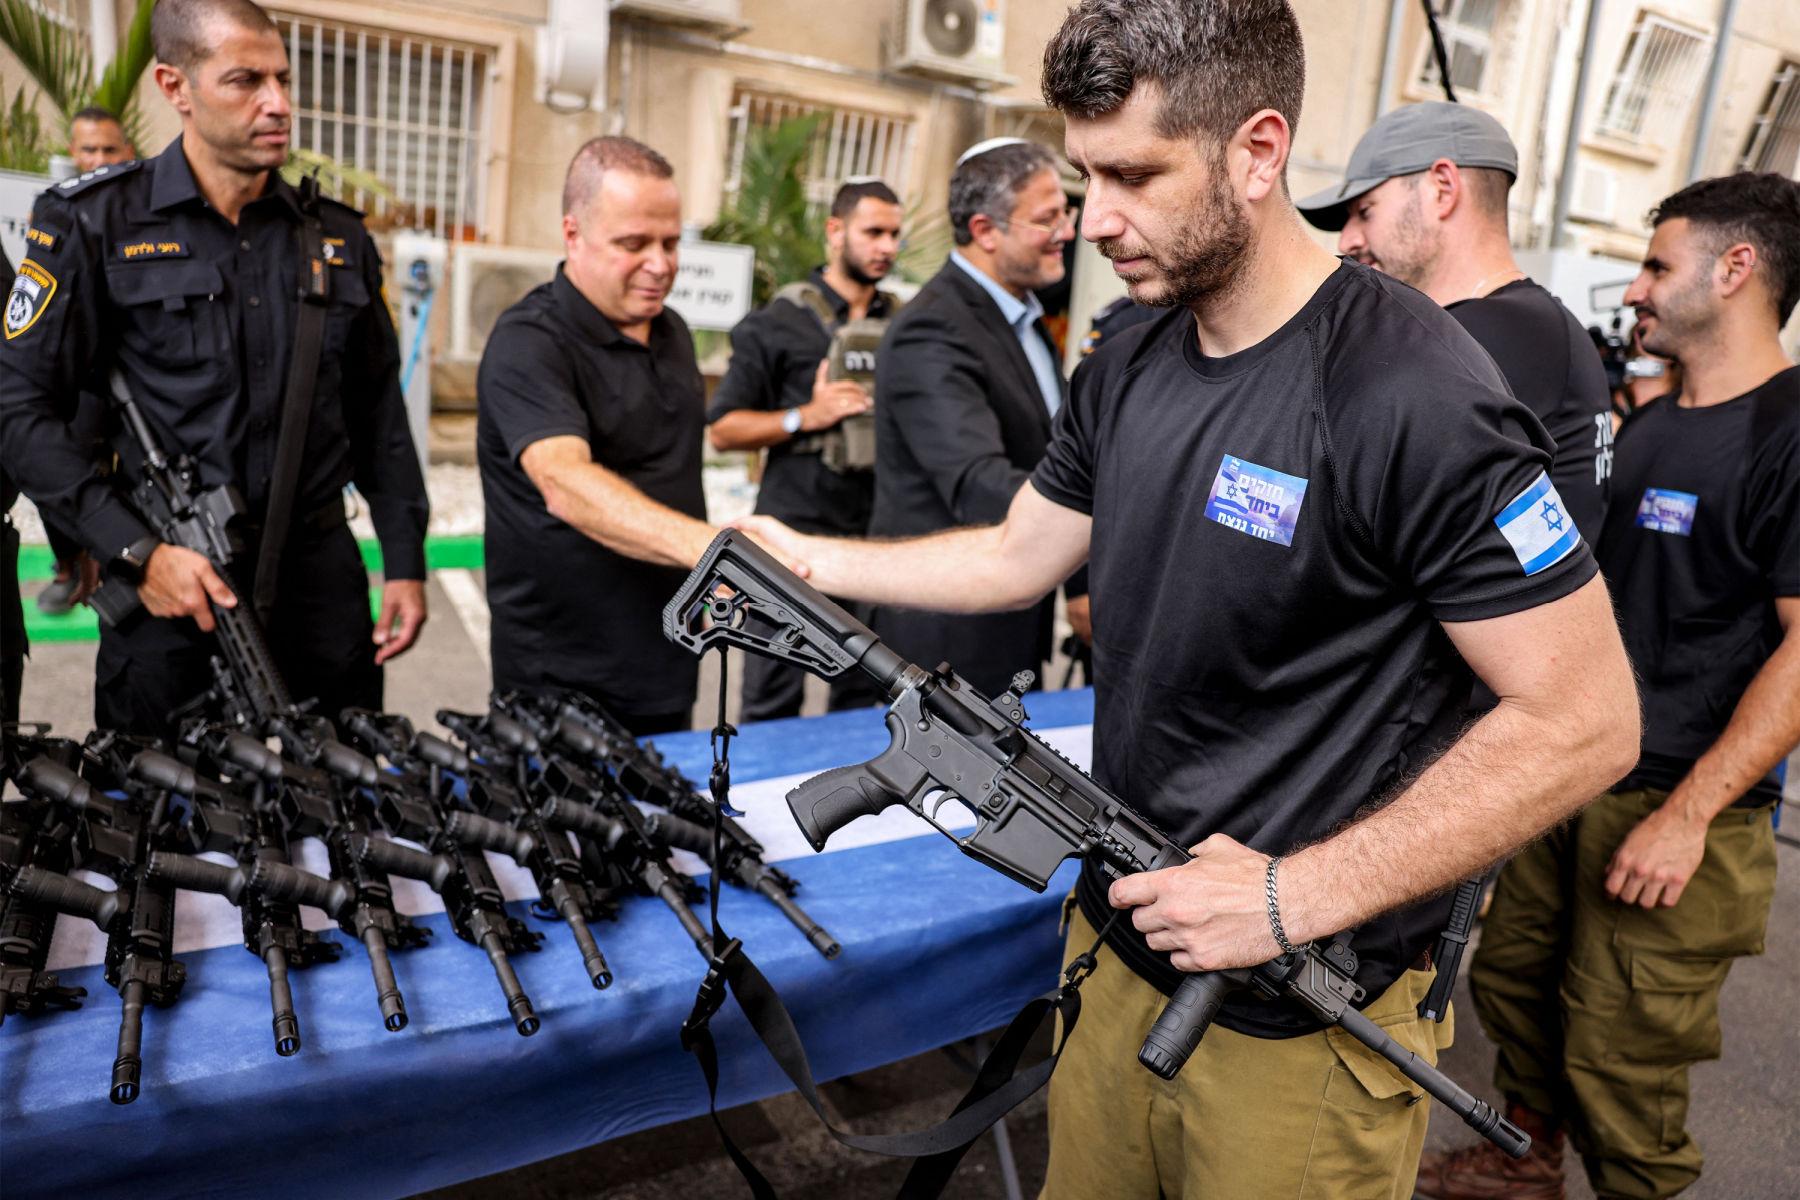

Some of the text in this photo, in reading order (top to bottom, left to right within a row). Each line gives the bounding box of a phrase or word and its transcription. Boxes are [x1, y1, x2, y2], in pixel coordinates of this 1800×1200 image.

[845, 350, 876, 370] רה
[1240, 474, 1285, 500] חזקים
[1246, 494, 1281, 520] ביחד
[1250, 523, 1275, 540] יחד
